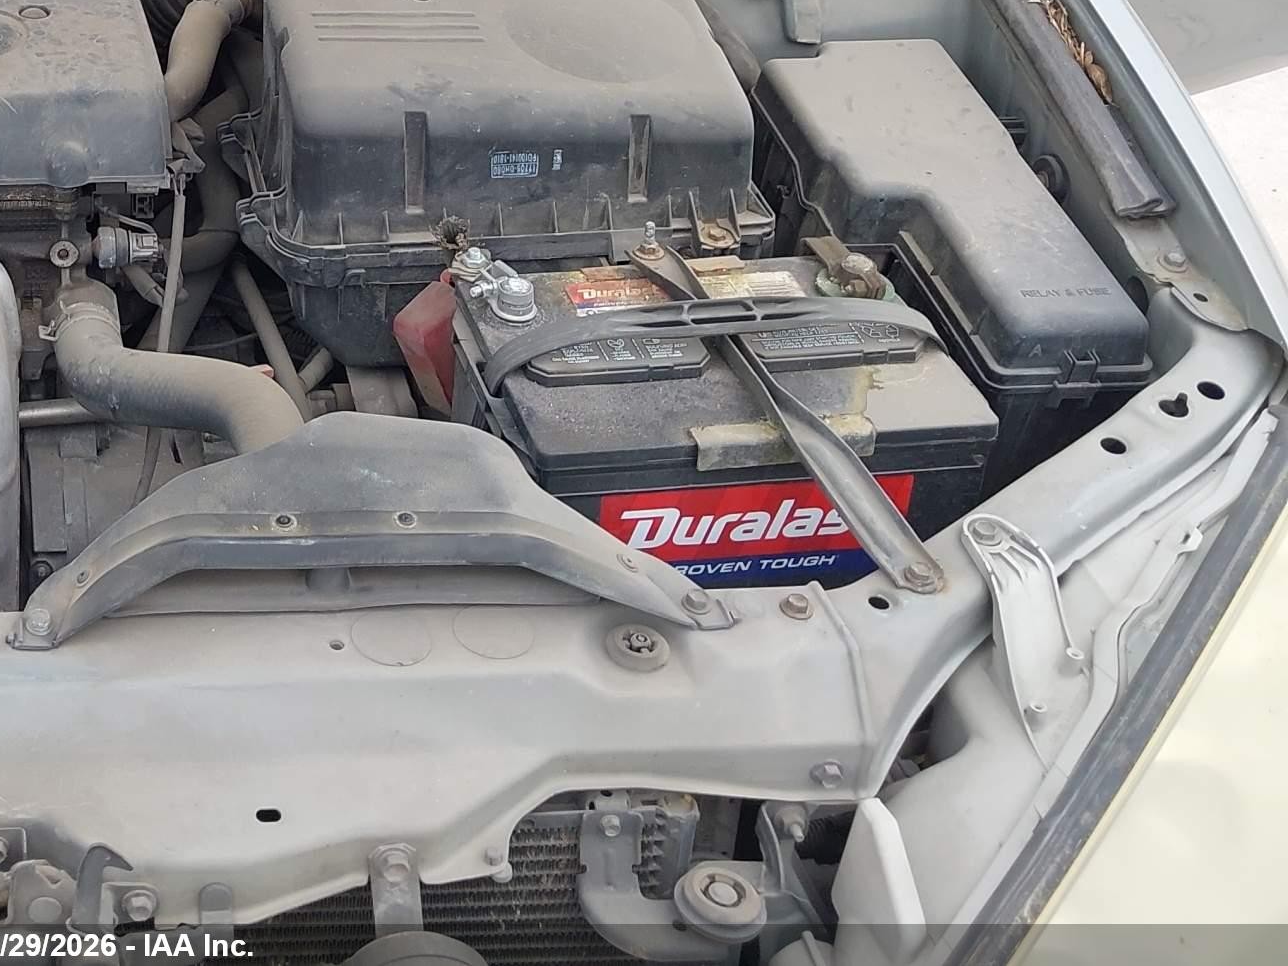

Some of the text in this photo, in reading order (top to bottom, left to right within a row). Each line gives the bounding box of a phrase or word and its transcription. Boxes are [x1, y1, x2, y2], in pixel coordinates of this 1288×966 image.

[1019, 289, 1061, 298] RELAY
[1076, 287, 1112, 297] FUSE
[620, 498, 850, 550] Duralas
[674, 554, 836, 576] ROVEN TOUGH
